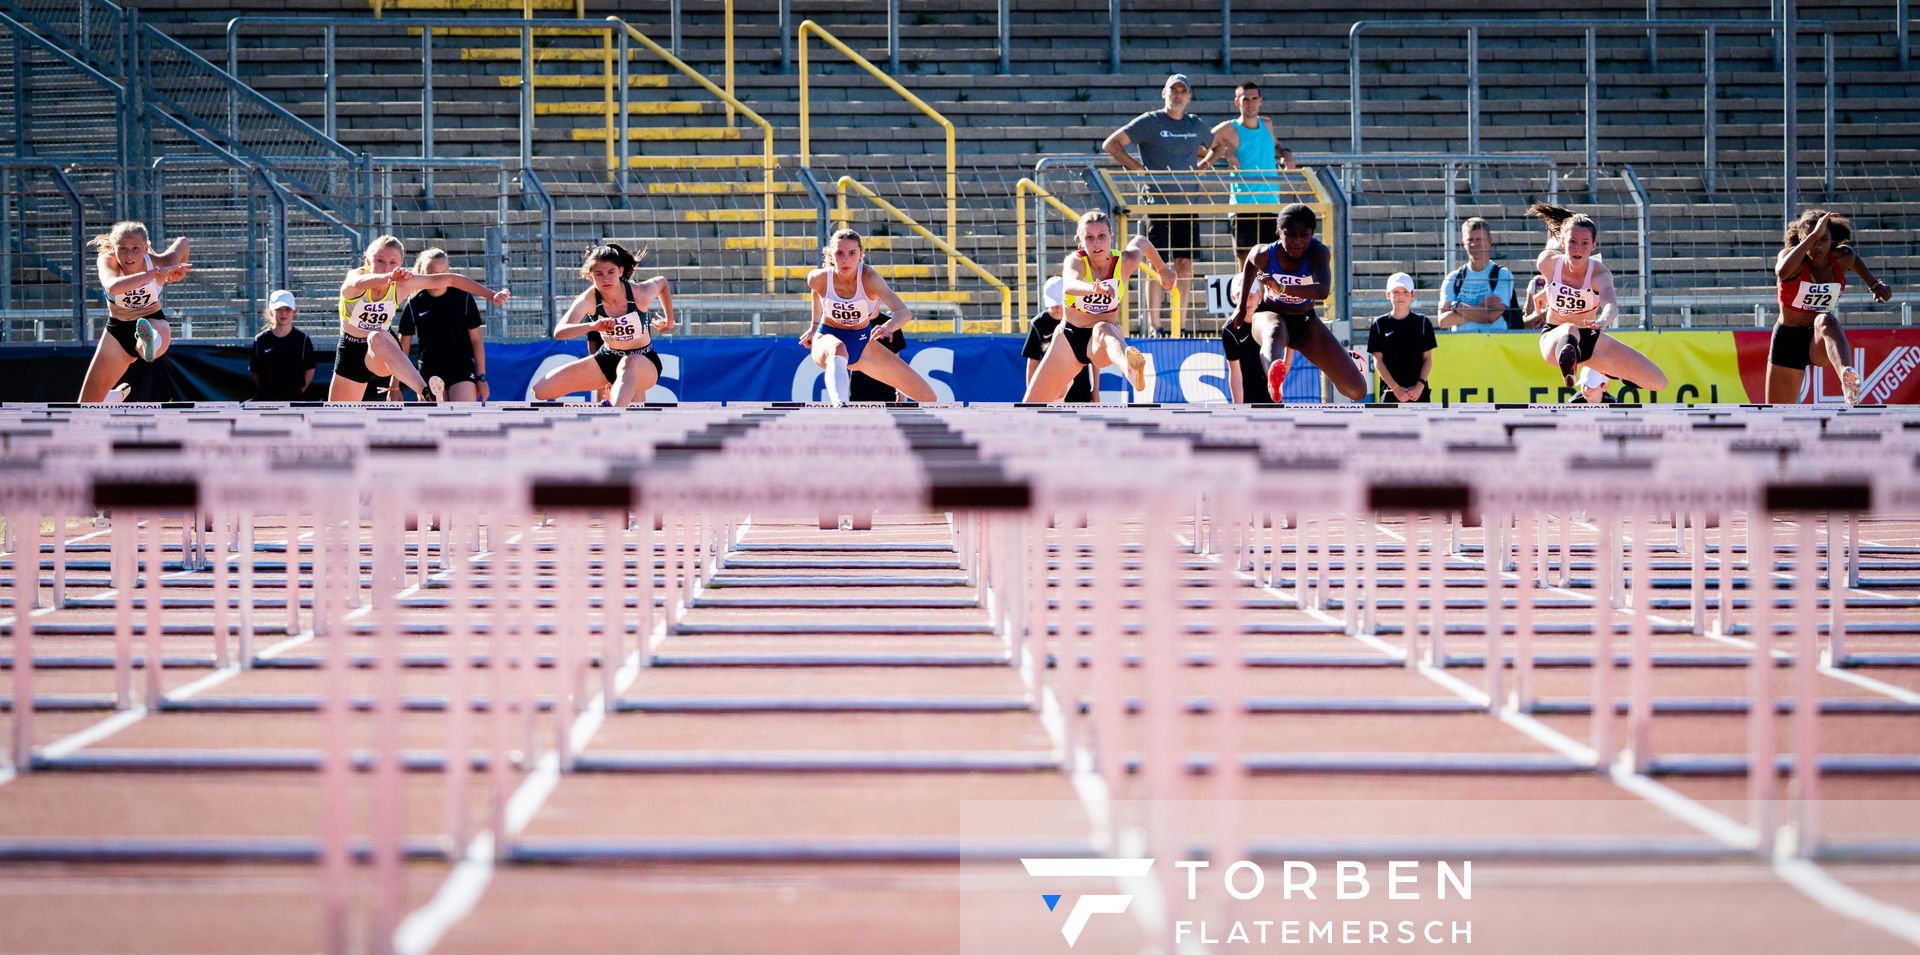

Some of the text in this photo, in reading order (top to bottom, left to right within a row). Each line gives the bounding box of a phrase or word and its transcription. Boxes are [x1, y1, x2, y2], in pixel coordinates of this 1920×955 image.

[1560, 281, 1581, 298] GLS
[1809, 285, 1829, 293] GLS
[122, 294, 151, 305] 427
[1083, 294, 1112, 304] 828
[1556, 295, 1586, 309] 539
[1802, 294, 1832, 306] 572
[364, 303, 384, 312] GLS
[359, 312, 388, 324] 439
[831, 310, 861, 320] 609
[615, 317, 628, 326] LS
